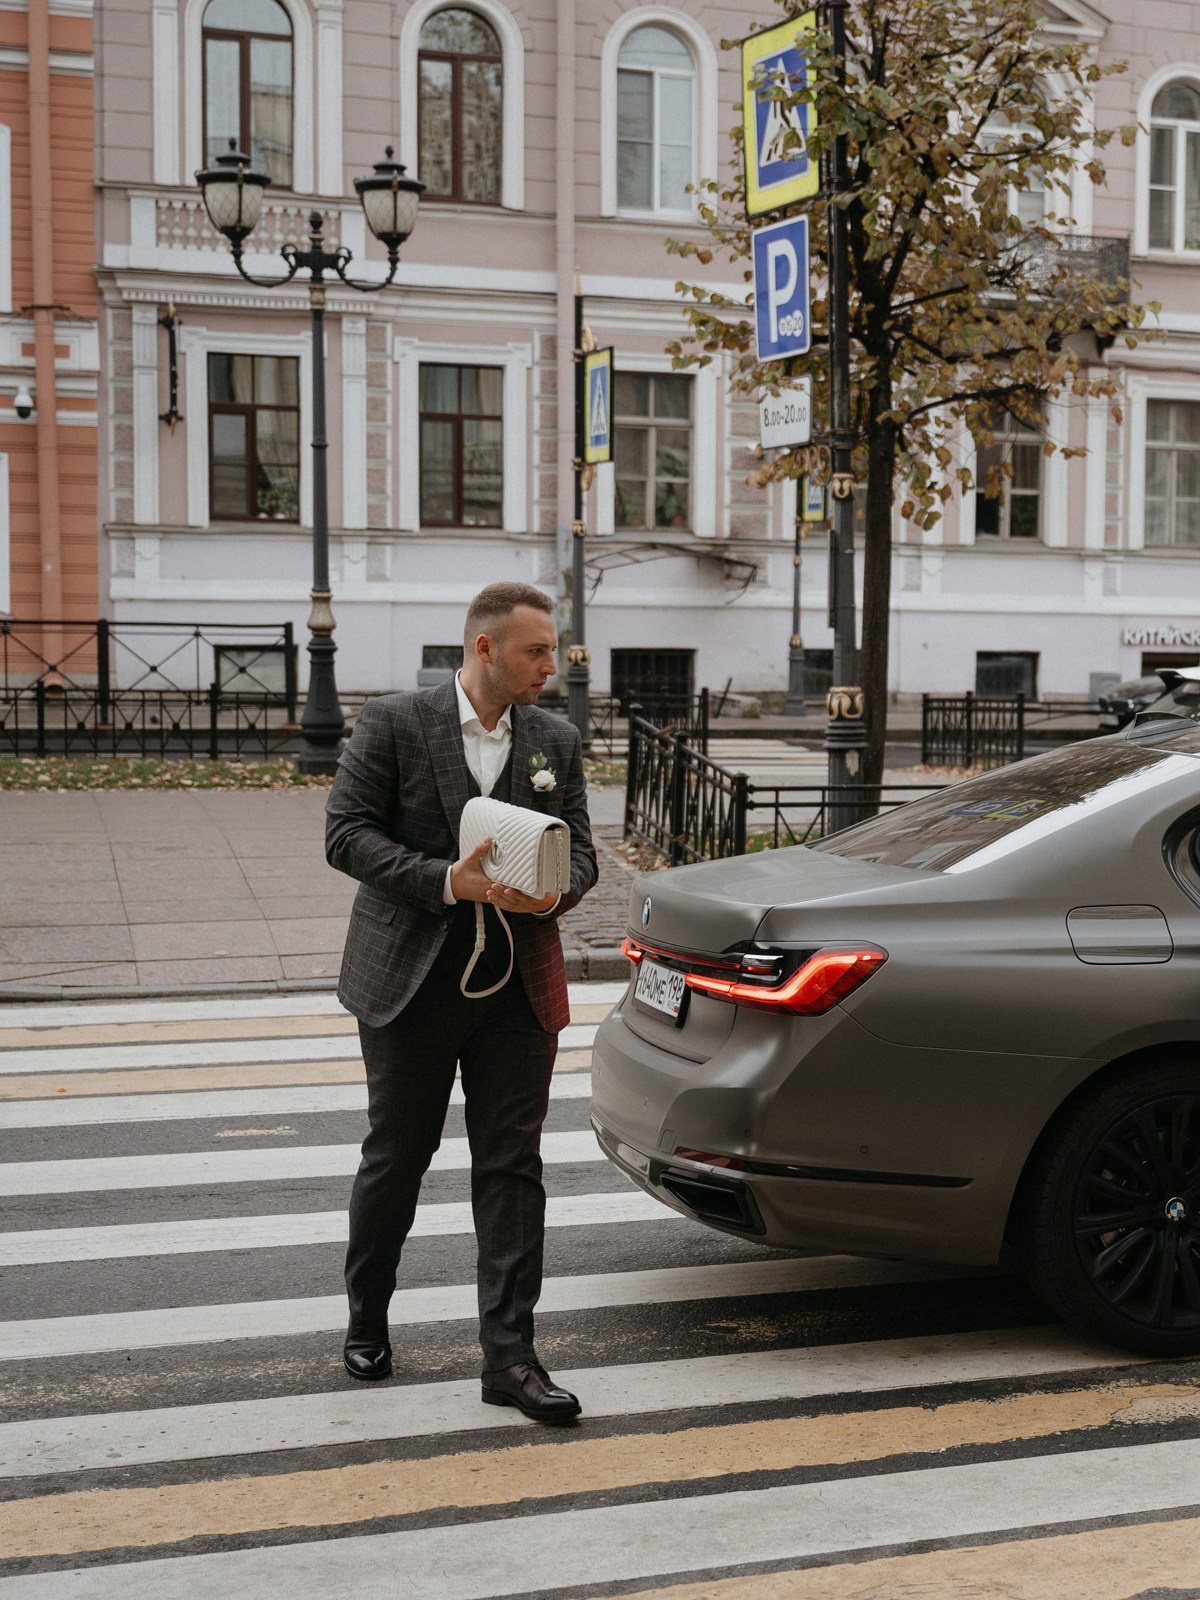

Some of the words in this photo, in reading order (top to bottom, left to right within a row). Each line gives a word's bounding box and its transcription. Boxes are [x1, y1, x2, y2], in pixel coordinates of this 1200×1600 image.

[767, 238, 798, 343] P
[793, 316, 803, 331] 20
[764, 404, 807, 427] 8.00-20.00
[669, 974, 683, 1001] 198
